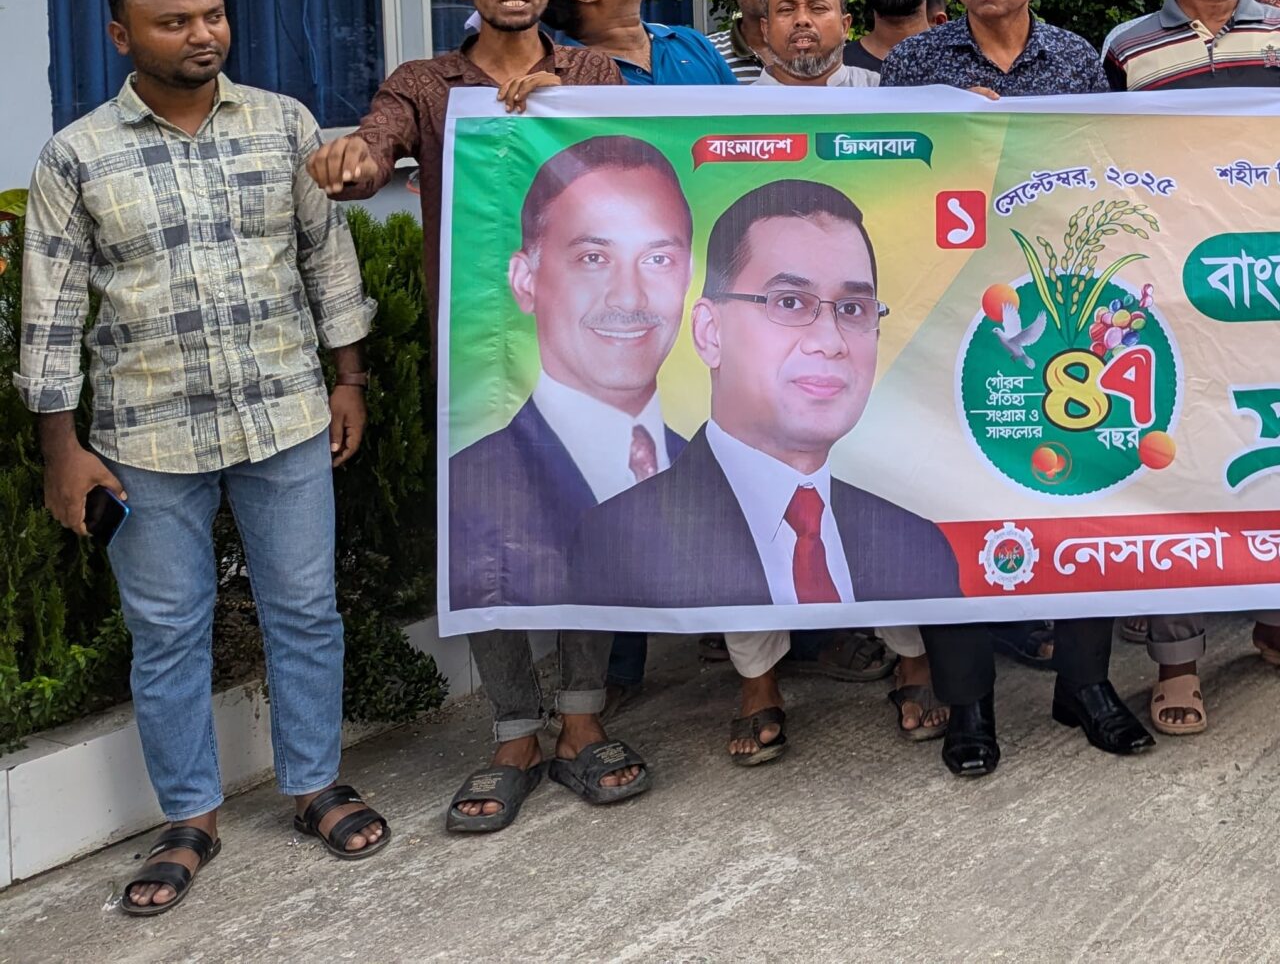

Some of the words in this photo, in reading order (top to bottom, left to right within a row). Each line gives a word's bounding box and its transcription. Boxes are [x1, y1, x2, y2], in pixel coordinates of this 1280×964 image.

[707, 138, 793, 159] বাংলাদেশ
[833, 134, 917, 157] জিন্দাবাদ
[1215, 161, 1270, 186] শহীদ
[947, 197, 975, 244] ১
[995, 168, 1096, 214] সেপ্টেম্বর,
[1106, 167, 1177, 194] ২০২৫
[985, 370, 1034, 389] গৌরব
[986, 388, 1045, 406] ঐতিহ্য
[971, 409, 1026, 423] সংগ্রাম
[1029, 409, 1040, 423] ও
[985, 425, 1043, 439] সাফল্যের
[1095, 427, 1142, 451] বছর
[1053, 526, 1231, 576] নেসকো
